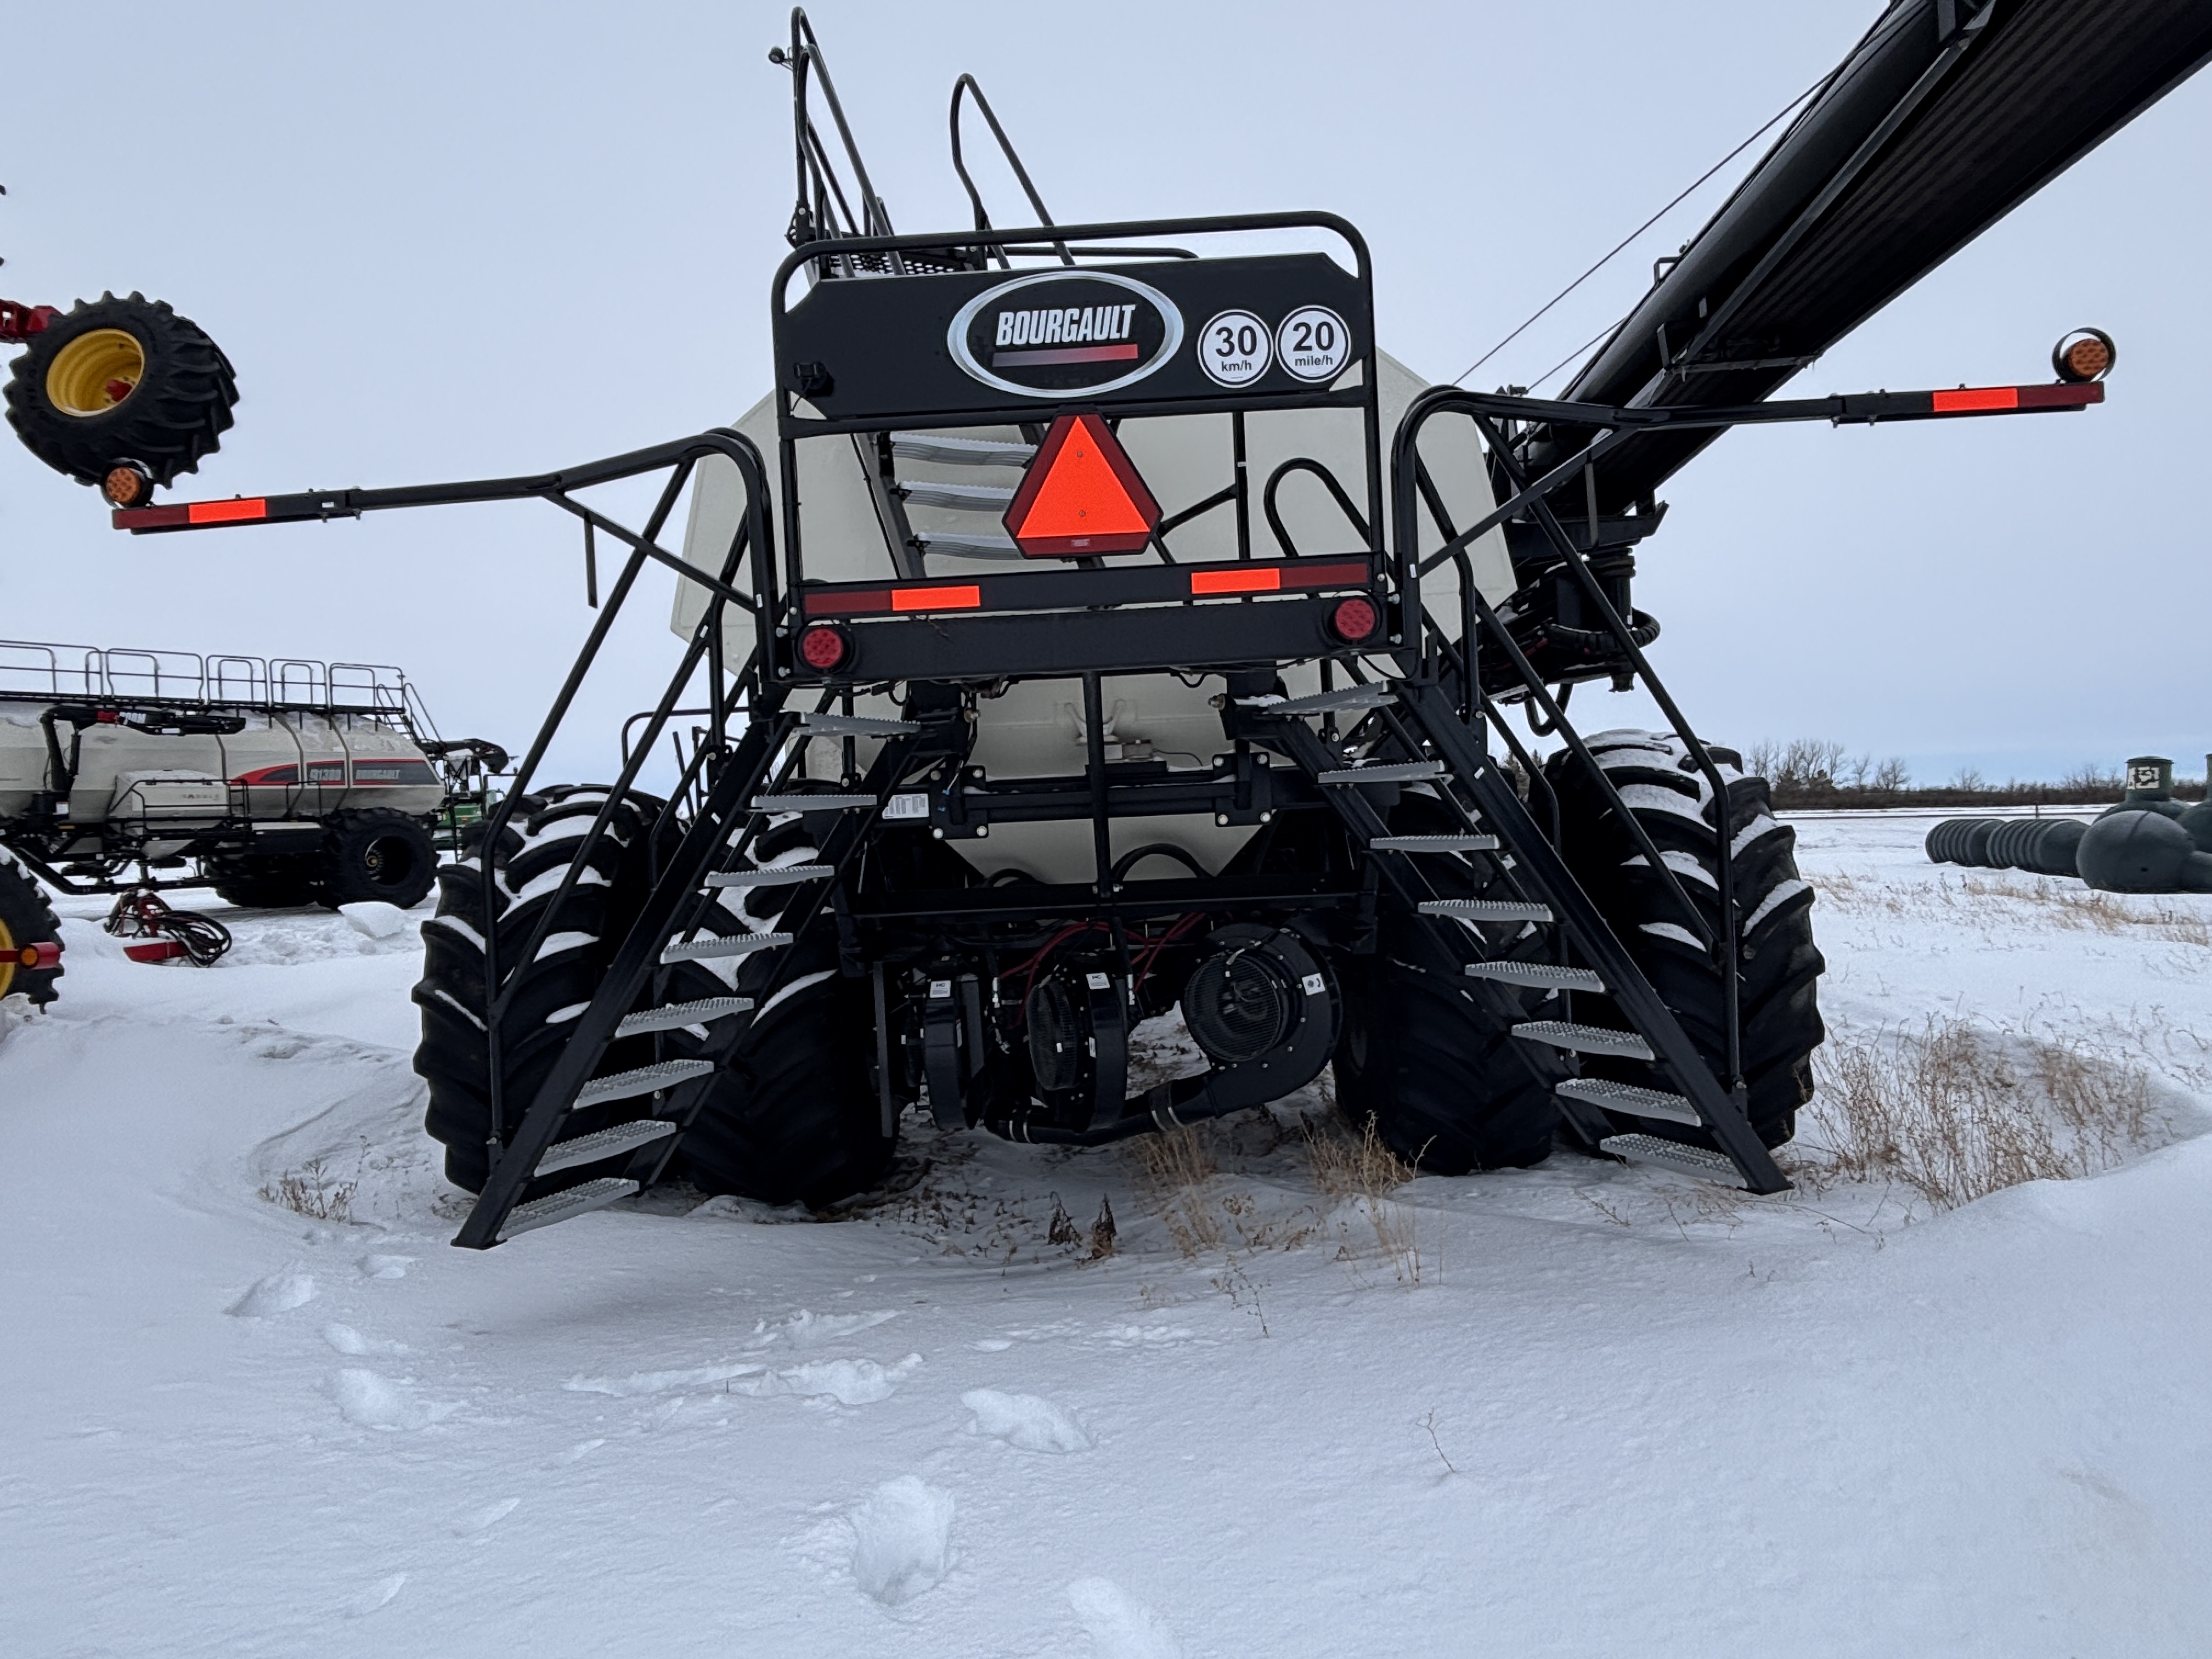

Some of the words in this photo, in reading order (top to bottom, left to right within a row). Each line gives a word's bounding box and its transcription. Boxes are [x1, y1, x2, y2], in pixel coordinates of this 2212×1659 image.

[996, 304, 1136, 346] BOURGAULT
[1293, 321, 1334, 352] 20
[1215, 325, 1257, 357] 30
[1221, 360, 1252, 372] km/h
[1295, 355, 1333, 366] mile/h
